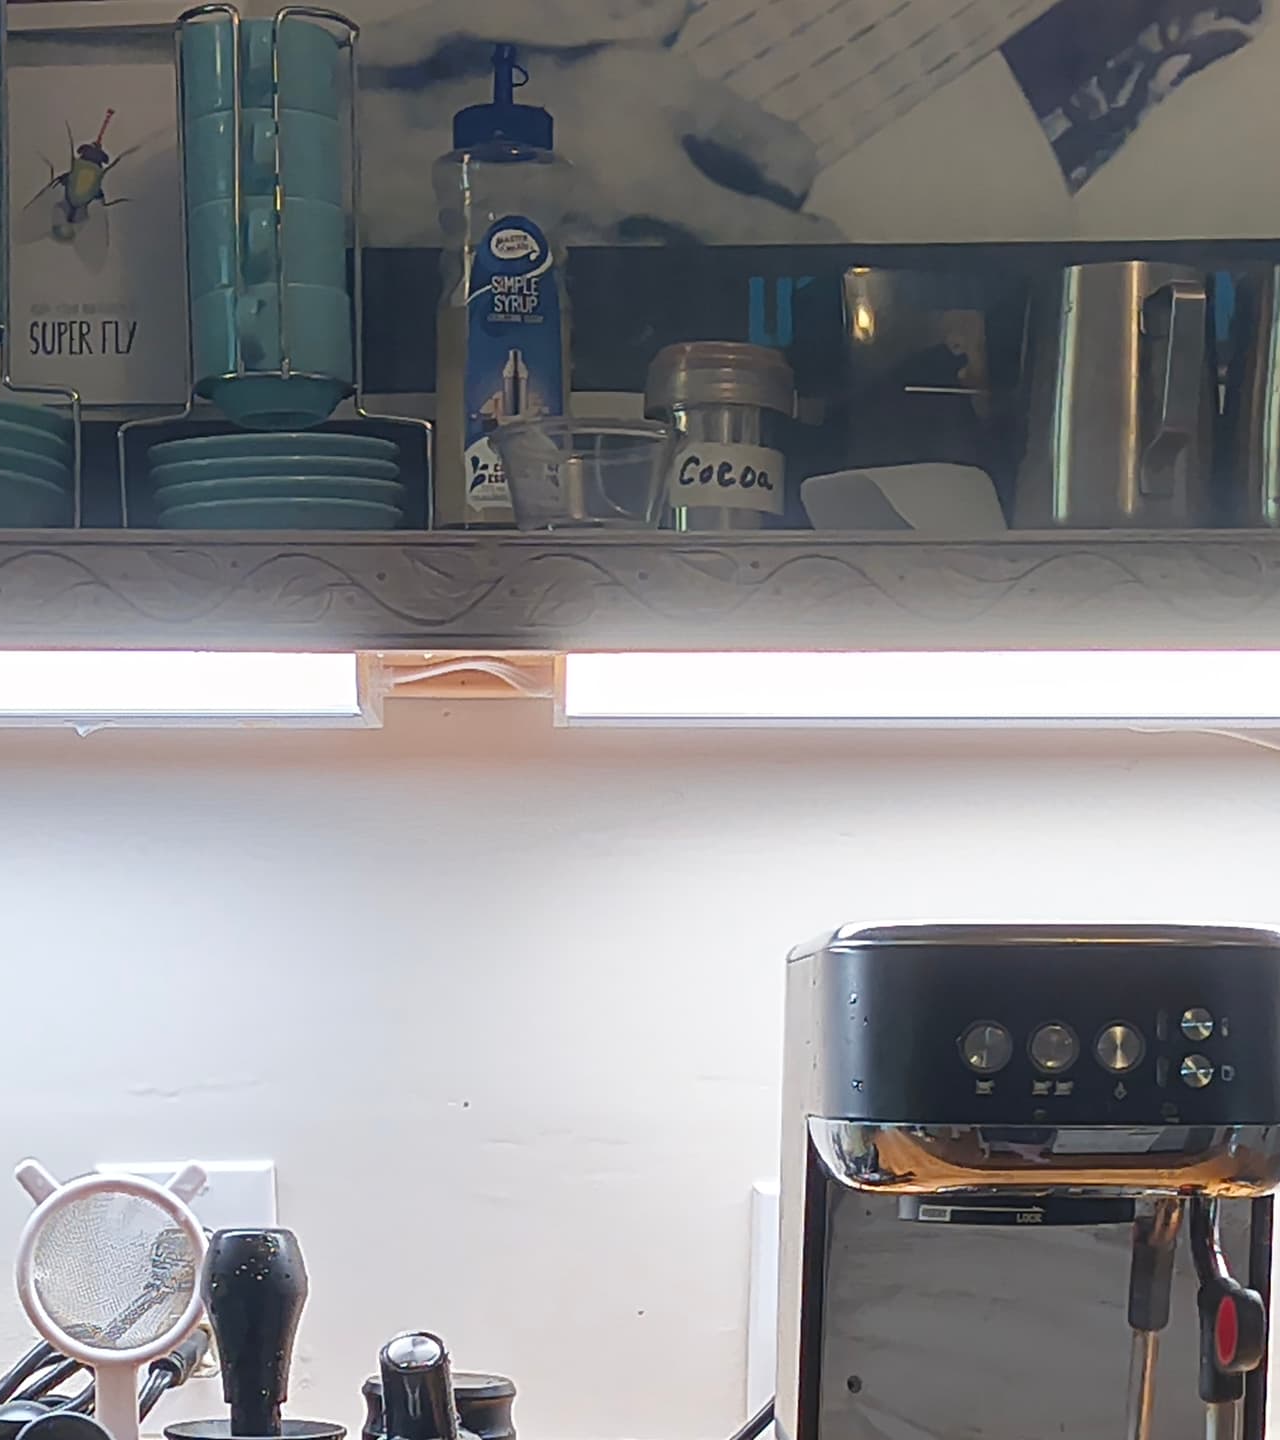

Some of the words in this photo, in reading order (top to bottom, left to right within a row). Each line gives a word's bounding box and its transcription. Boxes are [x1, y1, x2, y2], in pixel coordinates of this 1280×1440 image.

[491, 276, 539, 295] SIMPLE
[494, 295, 538, 313] SYRUP
[29, 320, 94, 355] SUPER
[101, 320, 138, 355] FLY
[679, 455, 774, 491] Cocoa
